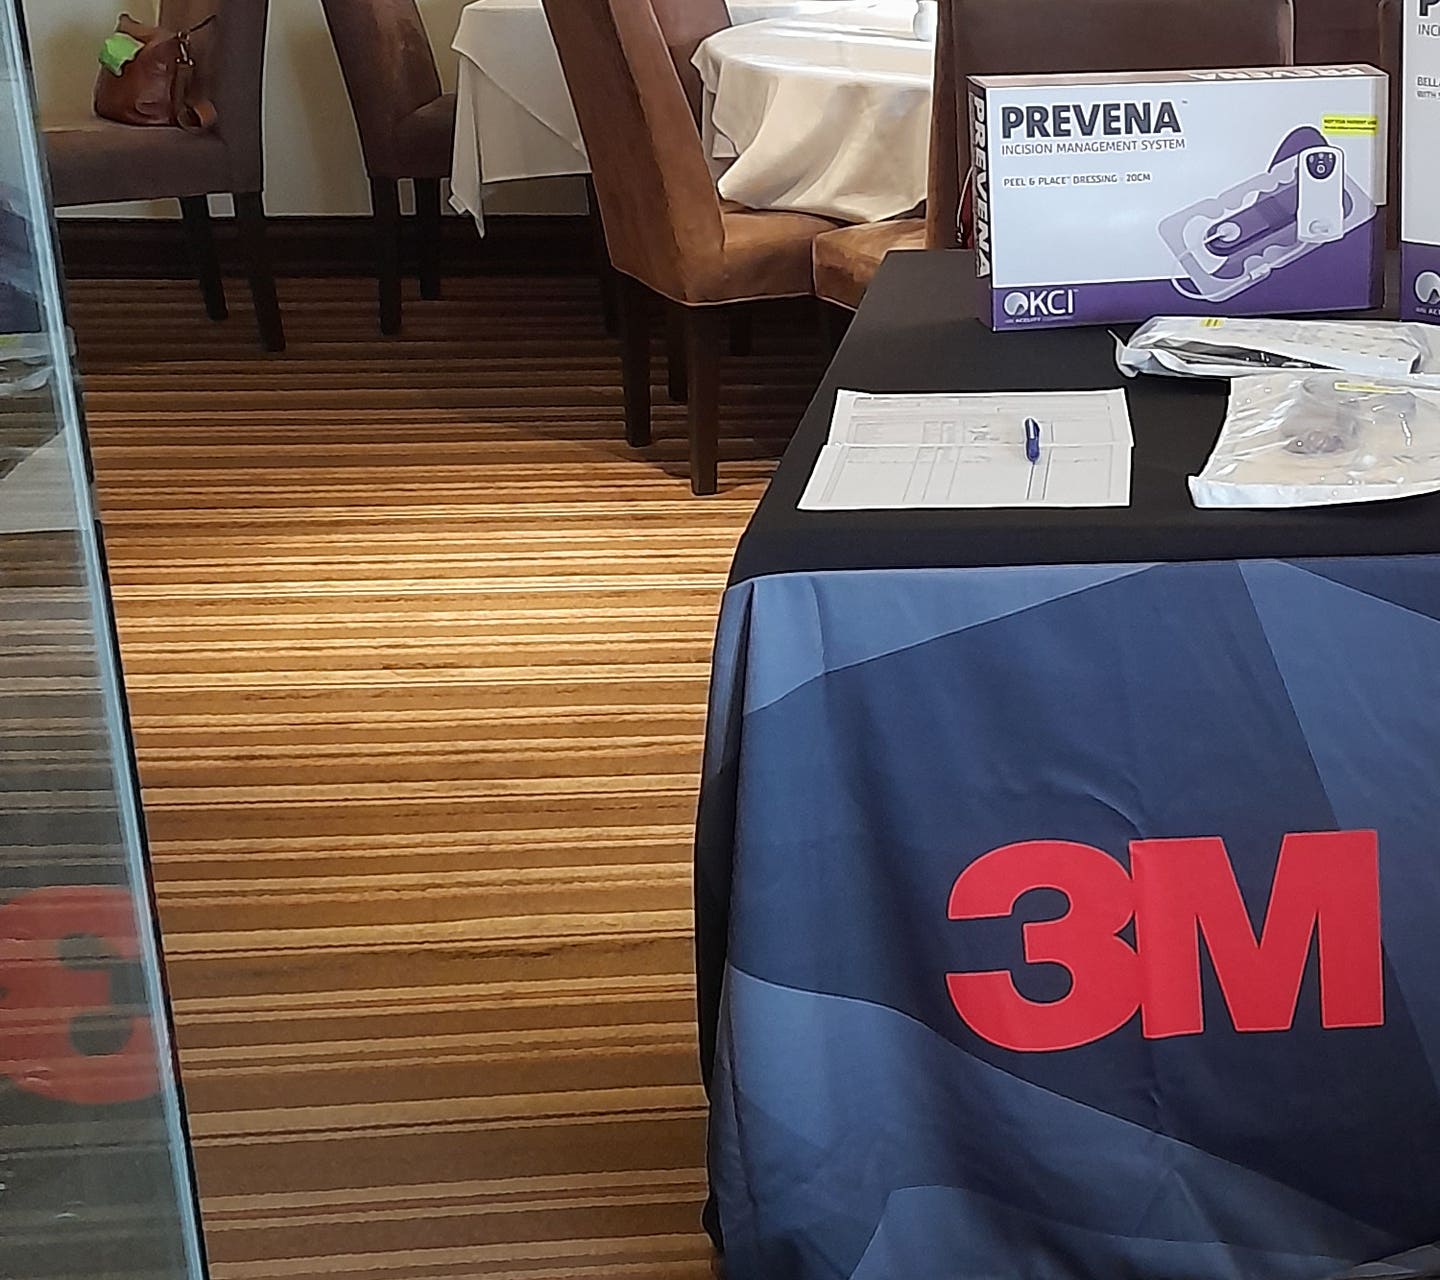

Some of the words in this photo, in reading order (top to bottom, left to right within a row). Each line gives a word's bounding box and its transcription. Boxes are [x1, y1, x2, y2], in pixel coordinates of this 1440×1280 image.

[1001, 102, 1182, 139] PREVENA
[1002, 143, 1052, 155] INCISION
[1056, 140, 1138, 153] MANAGEMENT
[1141, 138, 1185, 150] SYSTEM
[974, 95, 991, 278] PREVENA
[1003, 178, 1026, 187] PEEL
[1073, 174, 1118, 185] DRESSING
[1126, 173, 1151, 182] 20CM
[1029, 289, 1074, 316] KCI
[946, 829, 1384, 1052] 3M
